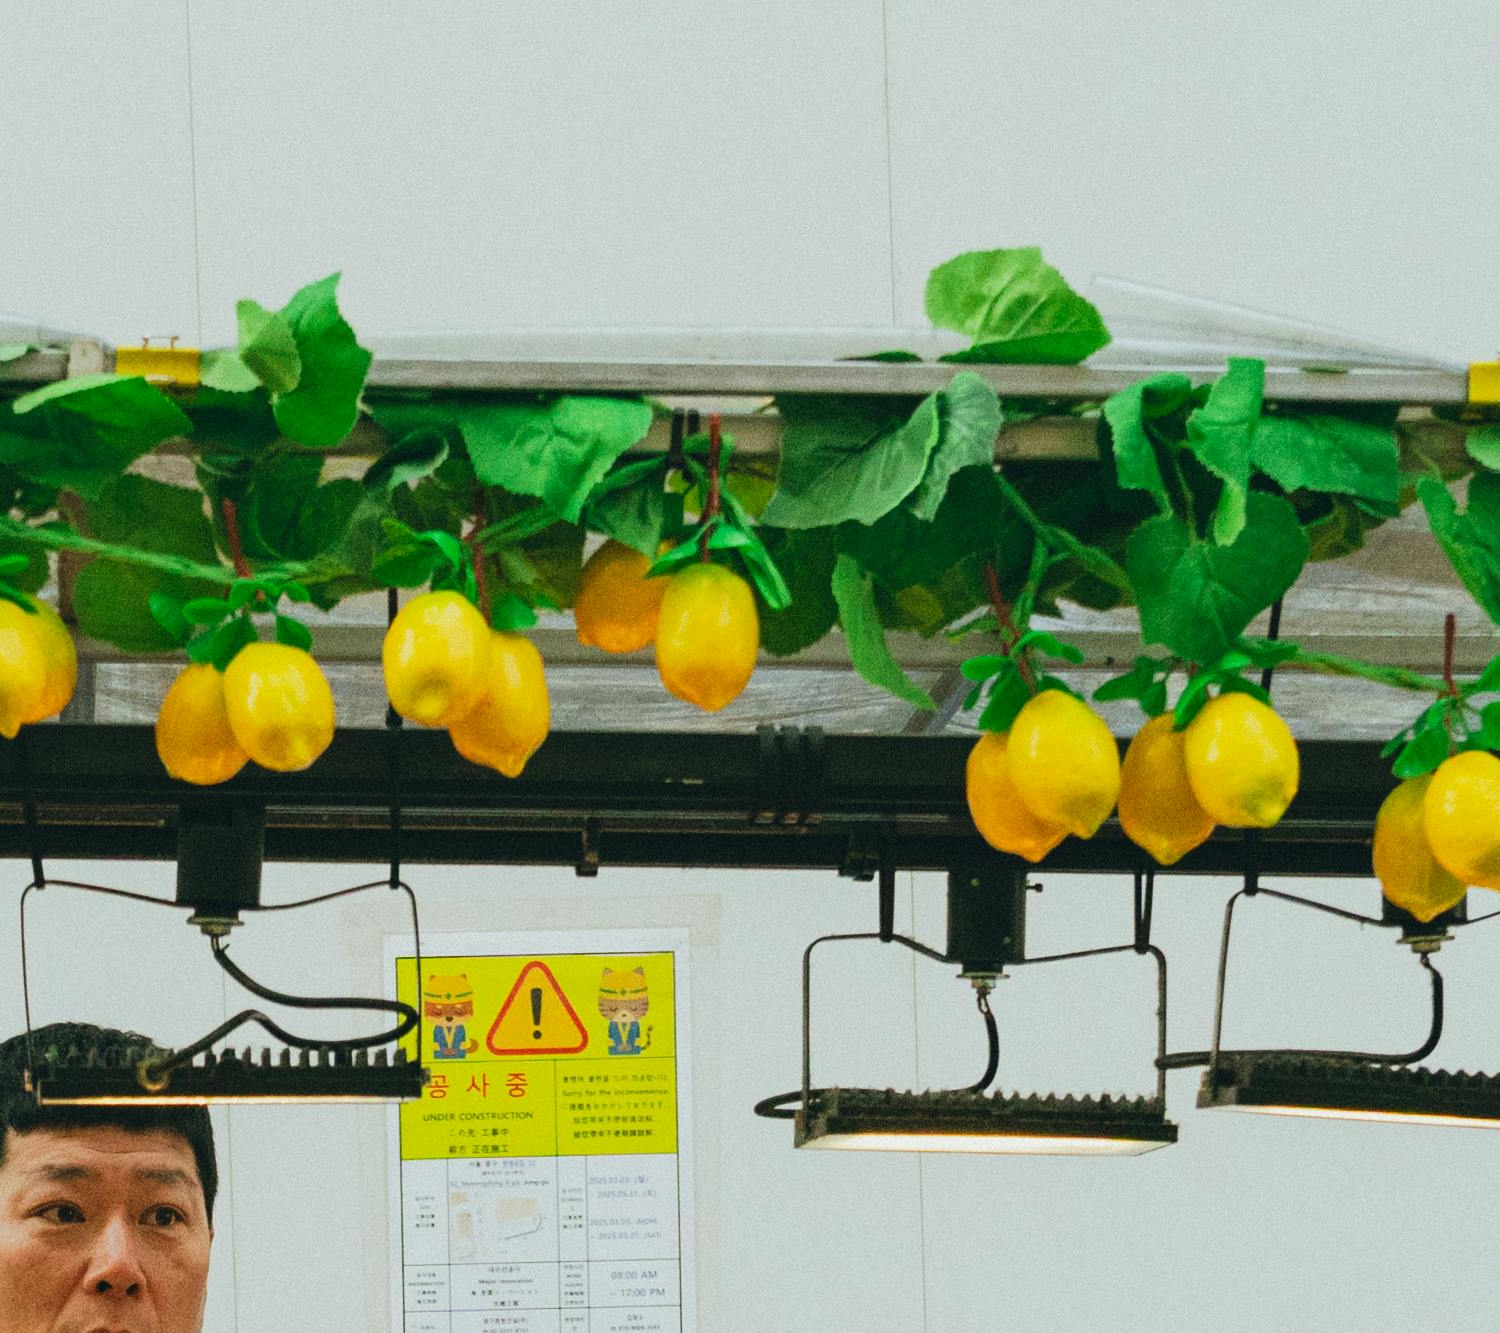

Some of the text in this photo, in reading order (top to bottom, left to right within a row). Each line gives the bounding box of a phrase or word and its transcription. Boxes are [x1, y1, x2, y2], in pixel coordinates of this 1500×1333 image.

[423, 1111, 534, 1121] UNDER CONSTRUCTION
[611, 1271, 658, 1280] 08:00 AM
[621, 1289, 646, 1297] 17:00
